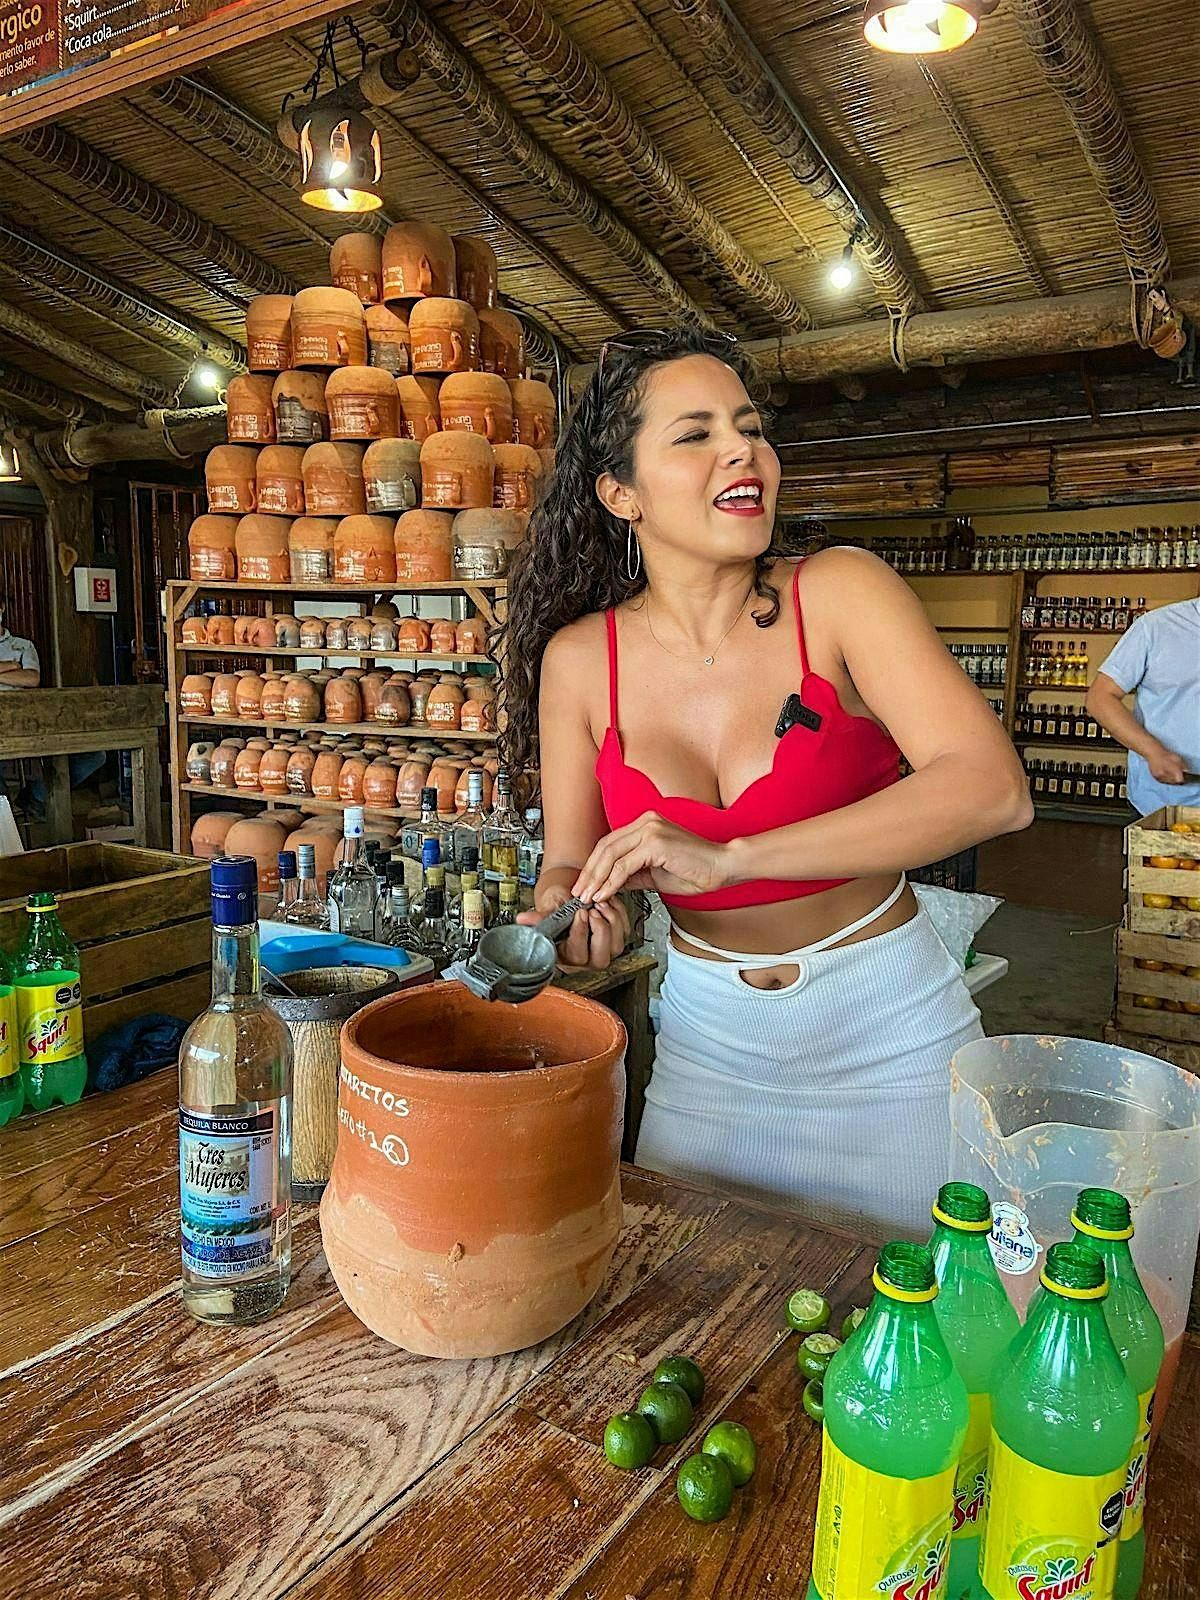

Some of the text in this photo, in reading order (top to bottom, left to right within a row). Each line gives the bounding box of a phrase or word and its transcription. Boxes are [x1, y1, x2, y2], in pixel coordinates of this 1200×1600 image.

[24, 34, 45, 51] favor
[45, 27, 56, 42] de
[27, 1015, 69, 1060] Squirt
[183, 1116, 249, 1131] TEQUILA BLANCO
[198, 1141, 226, 1166] Tres
[185, 1160, 247, 1194] Mujeres
